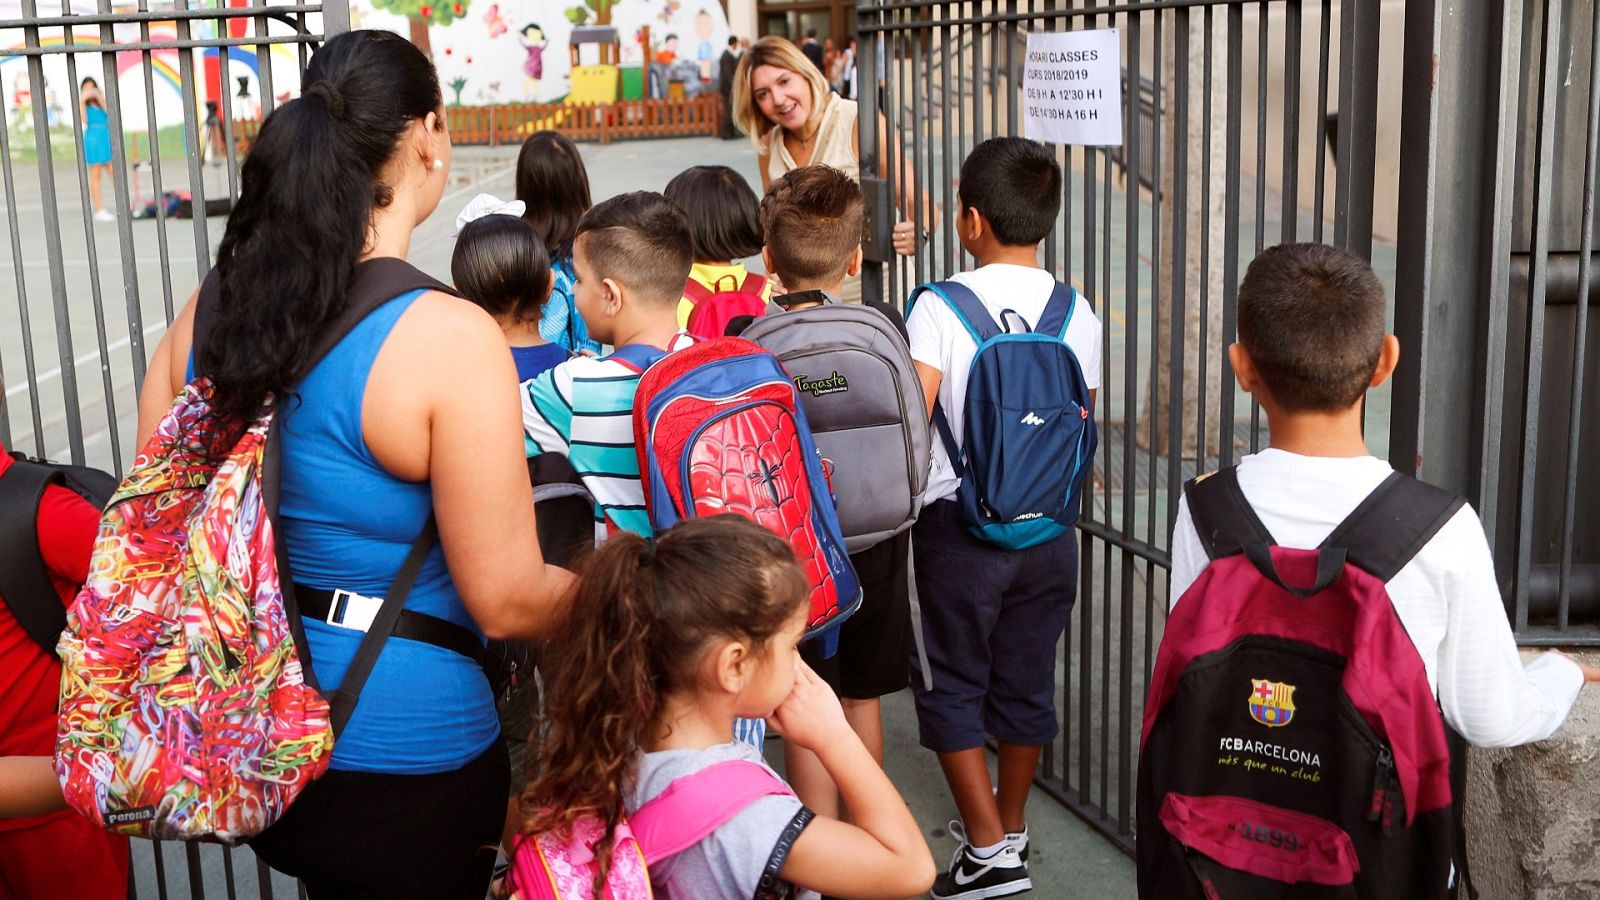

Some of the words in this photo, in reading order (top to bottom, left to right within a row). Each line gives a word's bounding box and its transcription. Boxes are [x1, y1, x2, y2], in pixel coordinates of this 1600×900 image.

[1029, 51, 1048, 61] HORARI
[1049, 50, 1098, 62] CLASSES
[1028, 69, 1042, 80] CURS
[1044, 69, 1088, 80] 2018/2019
[1028, 88, 1035, 98] DE
[1036, 89, 1041, 99] 9
[1042, 89, 1047, 99] H
[1050, 90, 1056, 100] A
[1060, 89, 1084, 100] 12'30
[1087, 89, 1095, 99] H
[1030, 107, 1039, 117] DE
[1040, 108, 1057, 119] 14'30
[1058, 109, 1064, 119] H
[1066, 110, 1072, 120] A
[1075, 110, 1086, 120] 16
[1089, 109, 1098, 120] H
[794, 371, 846, 396] Tagaste
[1244, 759, 1267, 772] que
[1271, 764, 1287, 775] un
[1291, 767, 1321, 783] club
